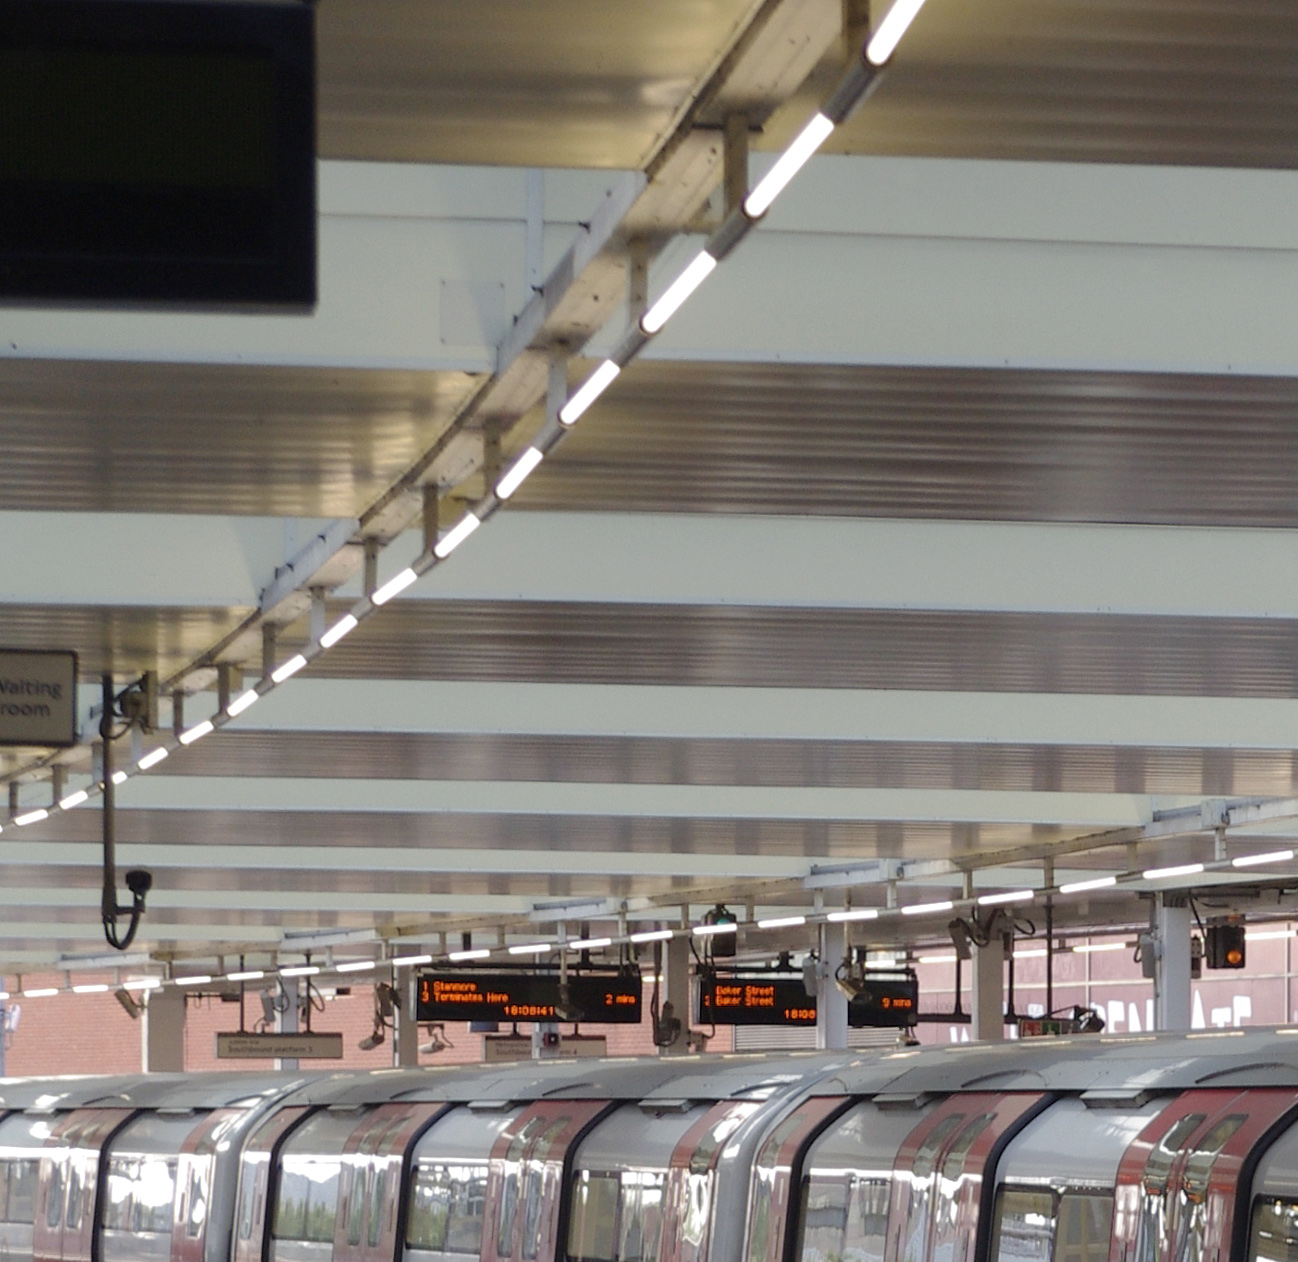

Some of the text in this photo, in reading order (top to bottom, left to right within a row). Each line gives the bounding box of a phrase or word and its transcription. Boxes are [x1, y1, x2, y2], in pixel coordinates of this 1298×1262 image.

[0, 704, 51, 716] room
[433, 980, 478, 992] Stanmore
[745, 985, 775, 997] Street
[486, 992, 510, 1003] Here
[605, 993, 614, 1006] 2
[745, 996, 775, 1007] Street
[785, 1008, 817, 1020] 18:08
